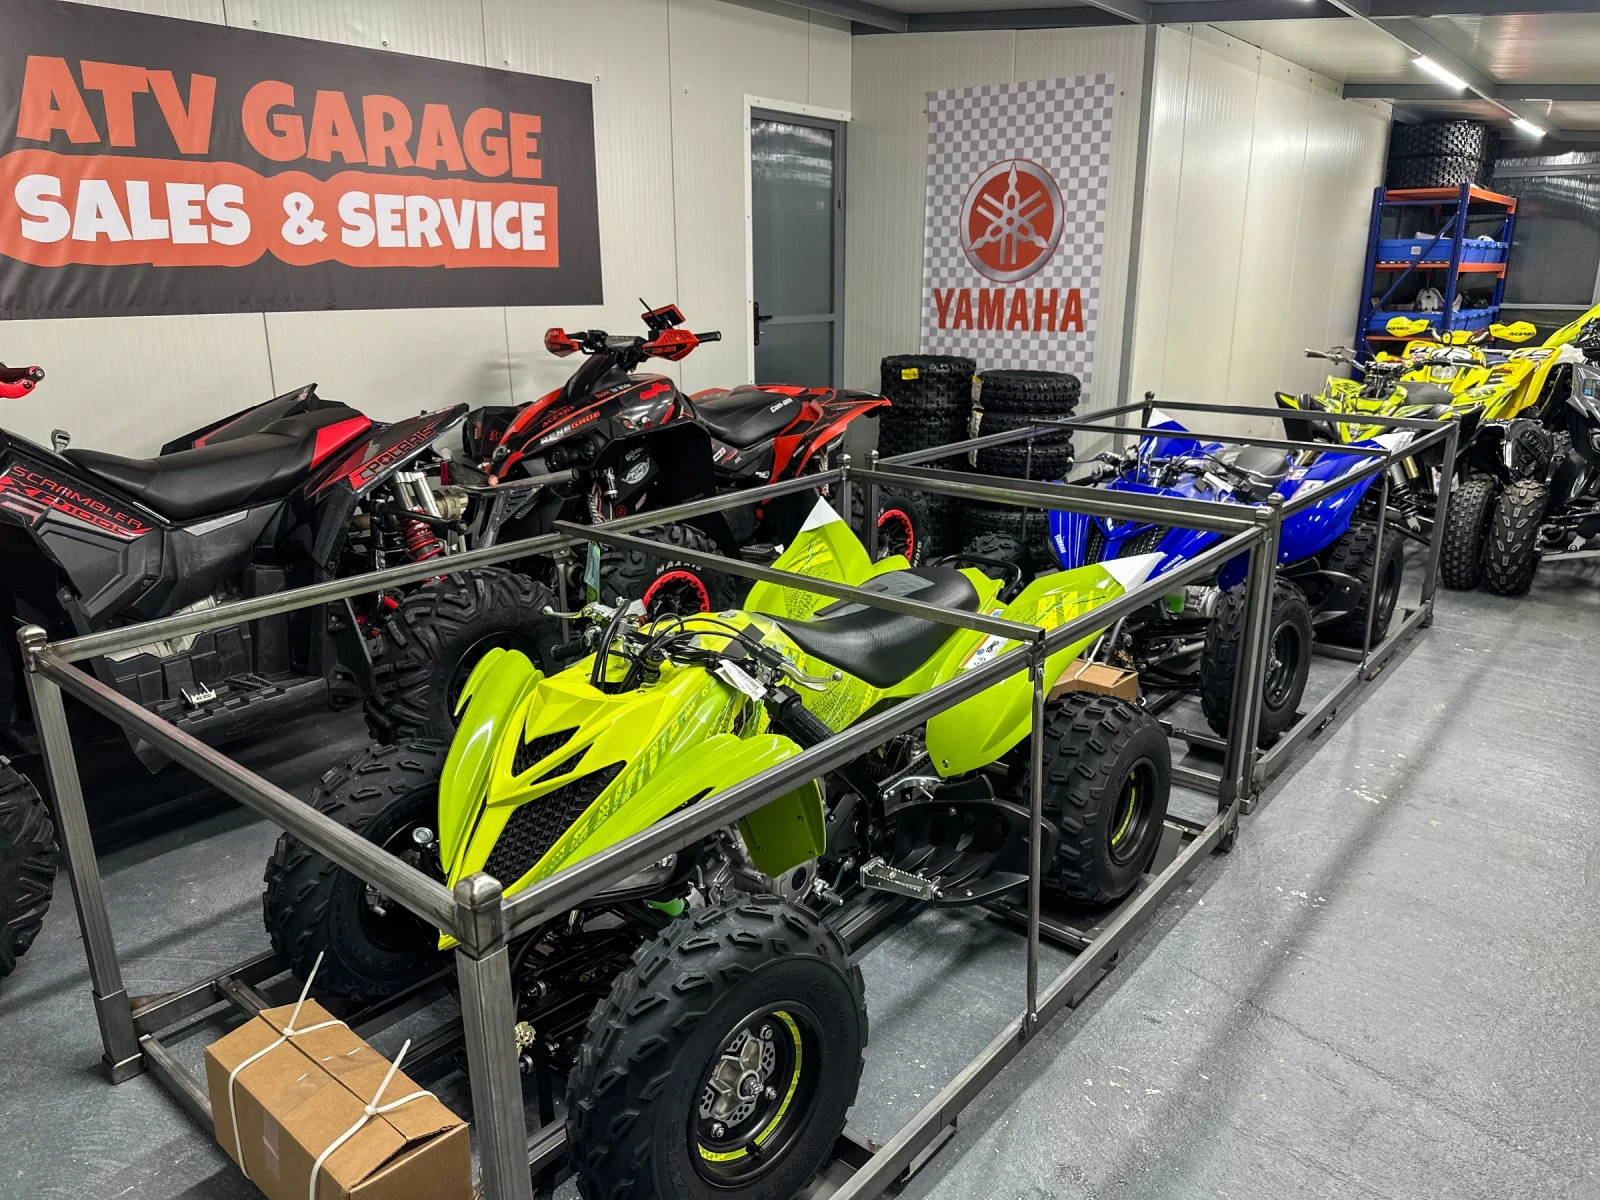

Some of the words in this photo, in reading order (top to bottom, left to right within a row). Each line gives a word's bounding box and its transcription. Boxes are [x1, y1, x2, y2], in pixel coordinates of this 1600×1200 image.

[16, 55, 217, 154] ATV
[241, 80, 542, 178] GARAGE
[14, 174, 251, 244] SALES
[281, 191, 328, 246] &
[338, 191, 546, 251] SERVICE
[933, 288, 1084, 333] YAMAHA
[368, 427, 437, 474] POLARIS
[11, 464, 143, 529] SCRAMBLER
[1055, 533, 1067, 554] YAMAHA
[1160, 554, 1184, 571] YAMAHA
